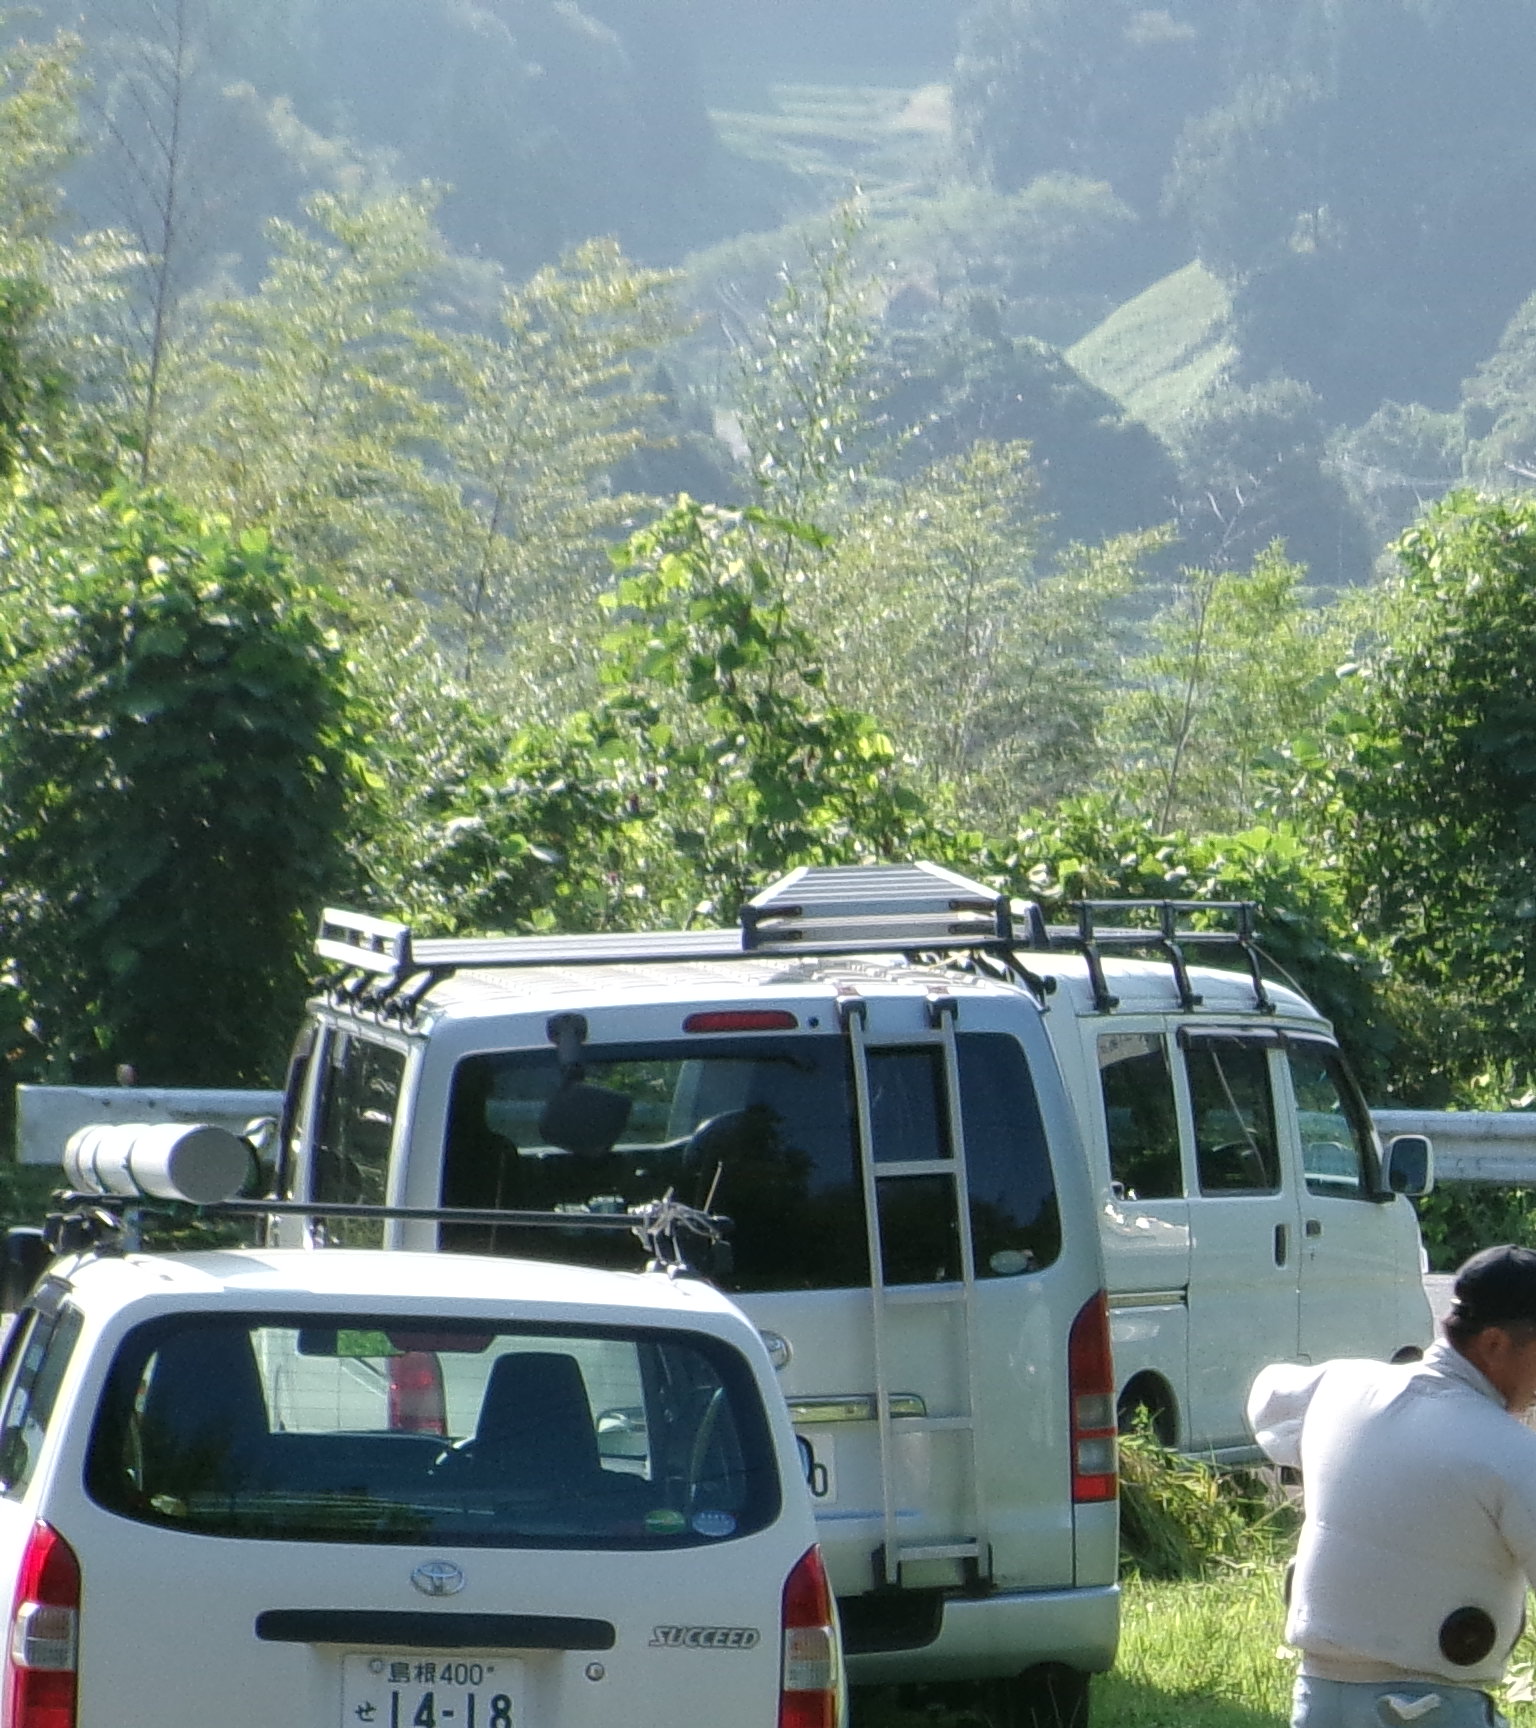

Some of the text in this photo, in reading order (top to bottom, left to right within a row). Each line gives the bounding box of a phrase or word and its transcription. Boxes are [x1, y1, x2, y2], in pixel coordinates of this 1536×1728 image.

[648, 1625, 760, 1649] SUCCEED
[388, 1662, 484, 1686] 島根400
[354, 1701, 378, 1722] せ
